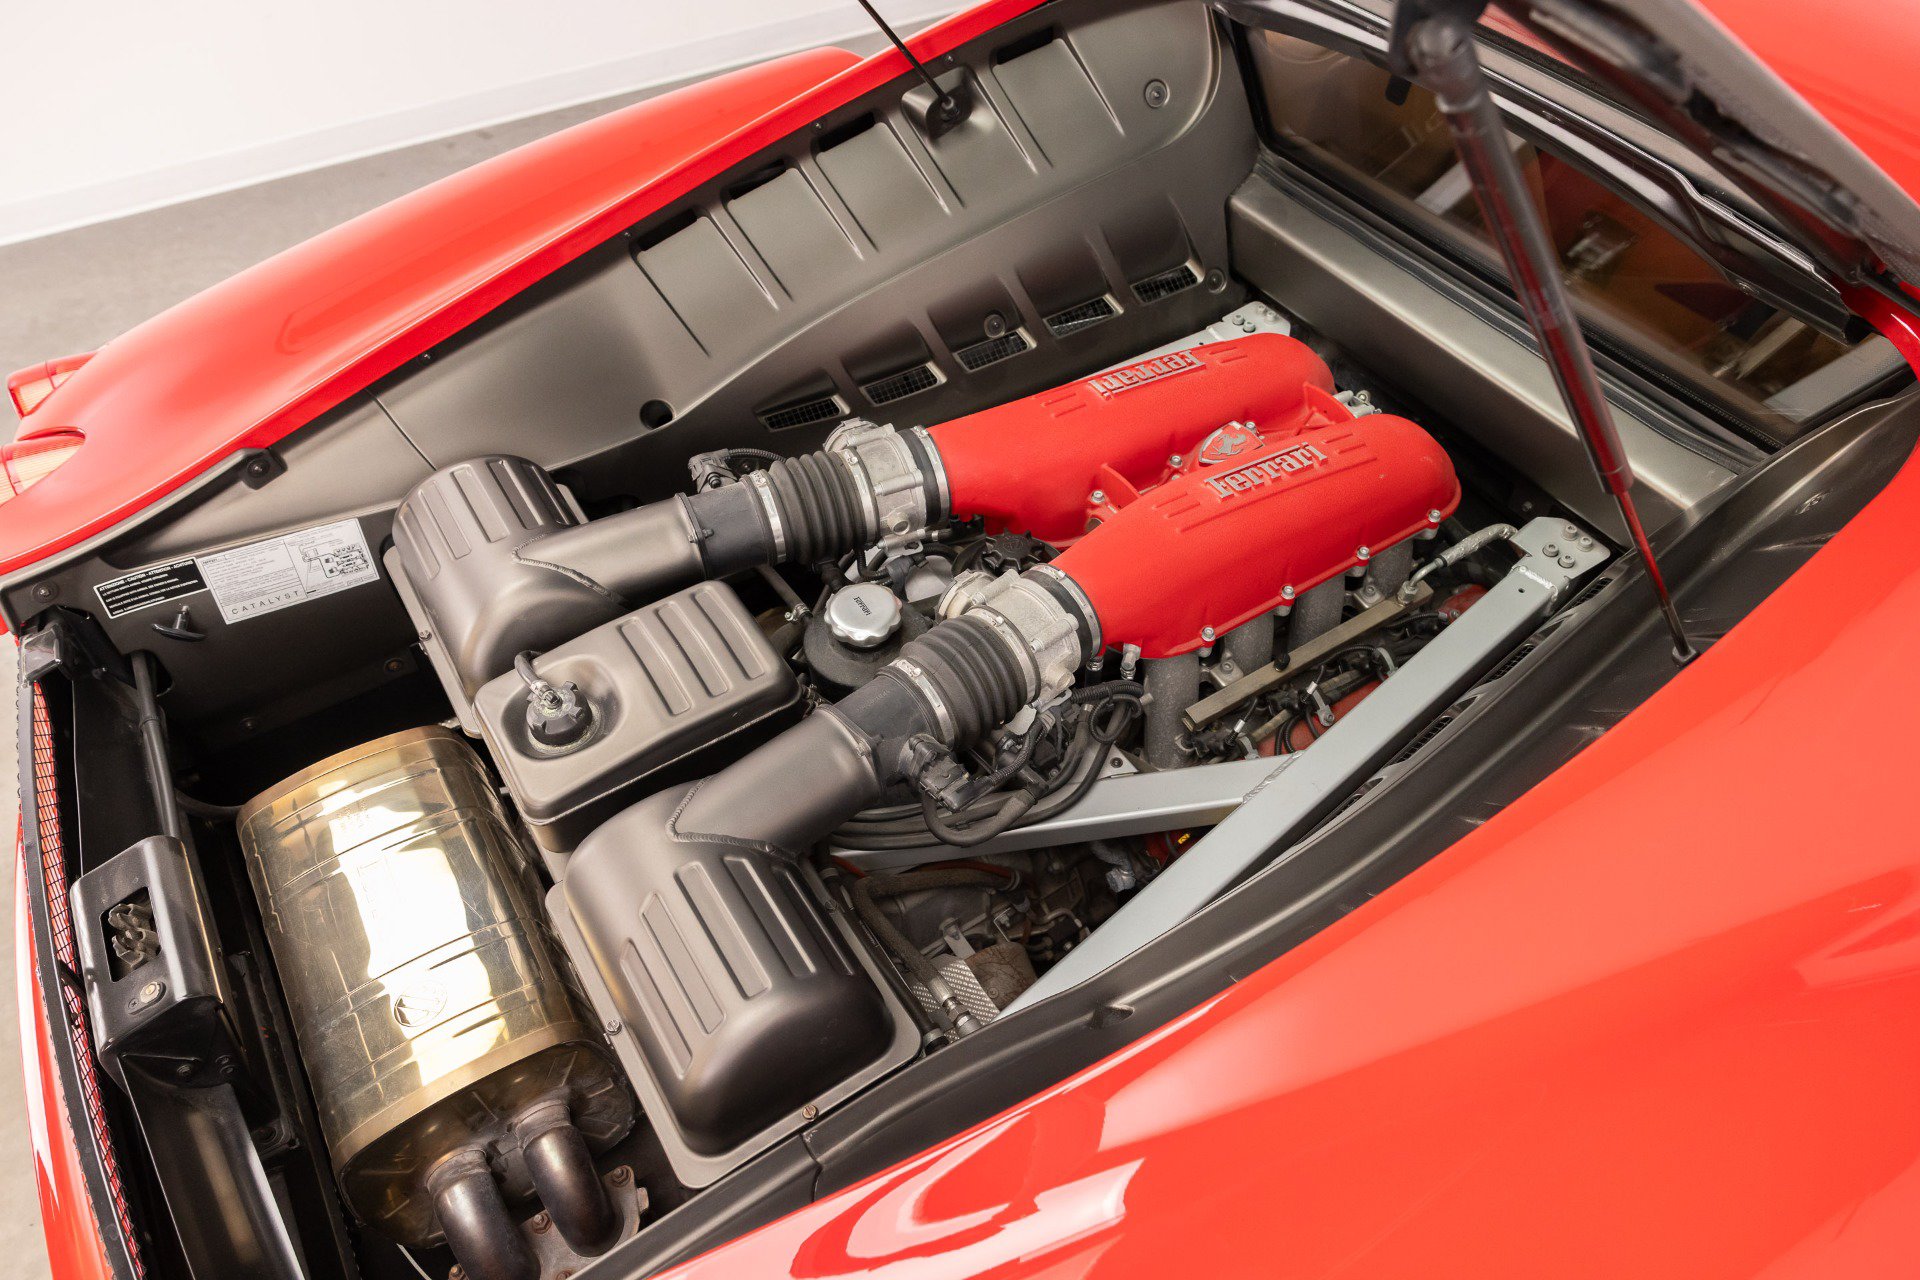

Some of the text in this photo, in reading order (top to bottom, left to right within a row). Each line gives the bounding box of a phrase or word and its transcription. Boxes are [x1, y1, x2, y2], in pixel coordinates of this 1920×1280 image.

[1088, 350, 1206, 400] Ferrari
[1204, 442, 1328, 499] Ferrari
[231, 590, 299, 614] CATALYST
[853, 596, 872, 616] Ferrari
